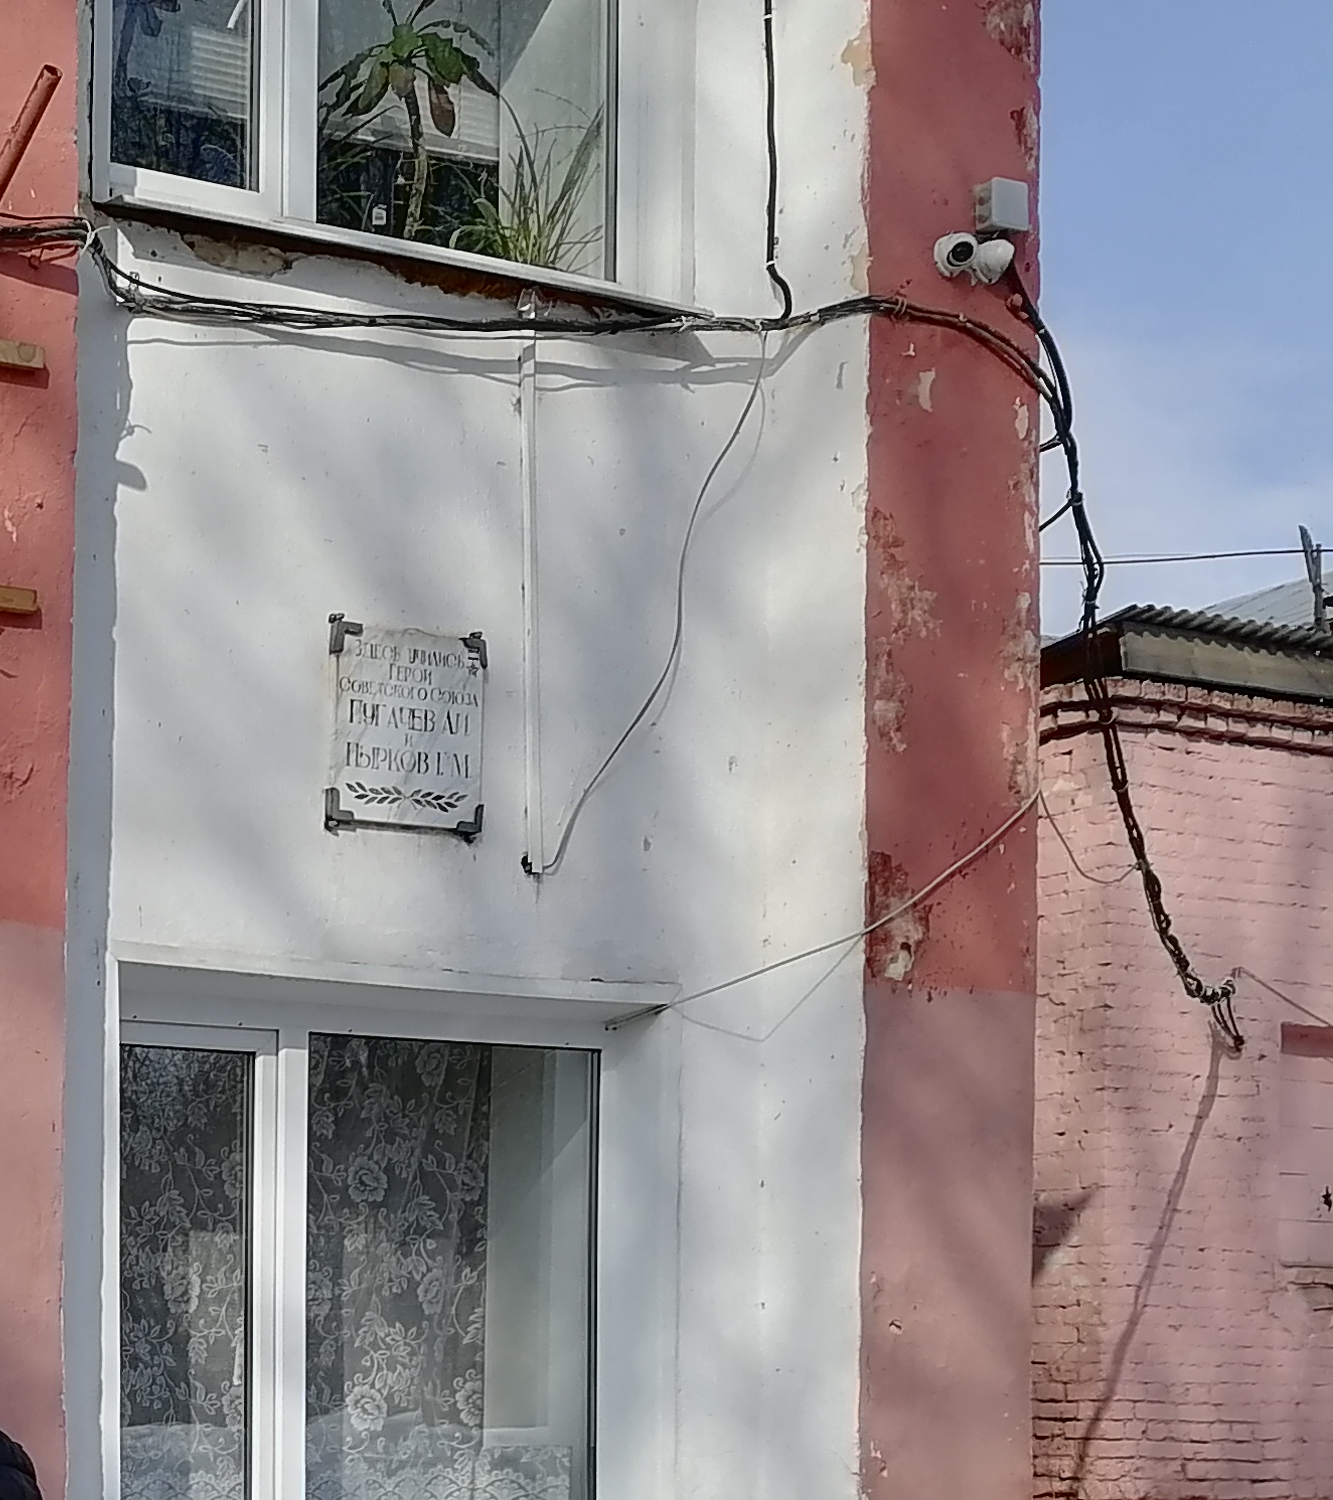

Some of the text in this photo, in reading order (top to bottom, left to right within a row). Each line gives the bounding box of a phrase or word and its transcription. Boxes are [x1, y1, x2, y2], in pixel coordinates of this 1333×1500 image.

[355, 638, 401, 663] ЗДЕСЬ
[389, 663, 433, 686] ГЕРОИ
[339, 676, 428, 701] СОВЕТСКОГО
[349, 698, 436, 733] ПУГАЧЕВ
